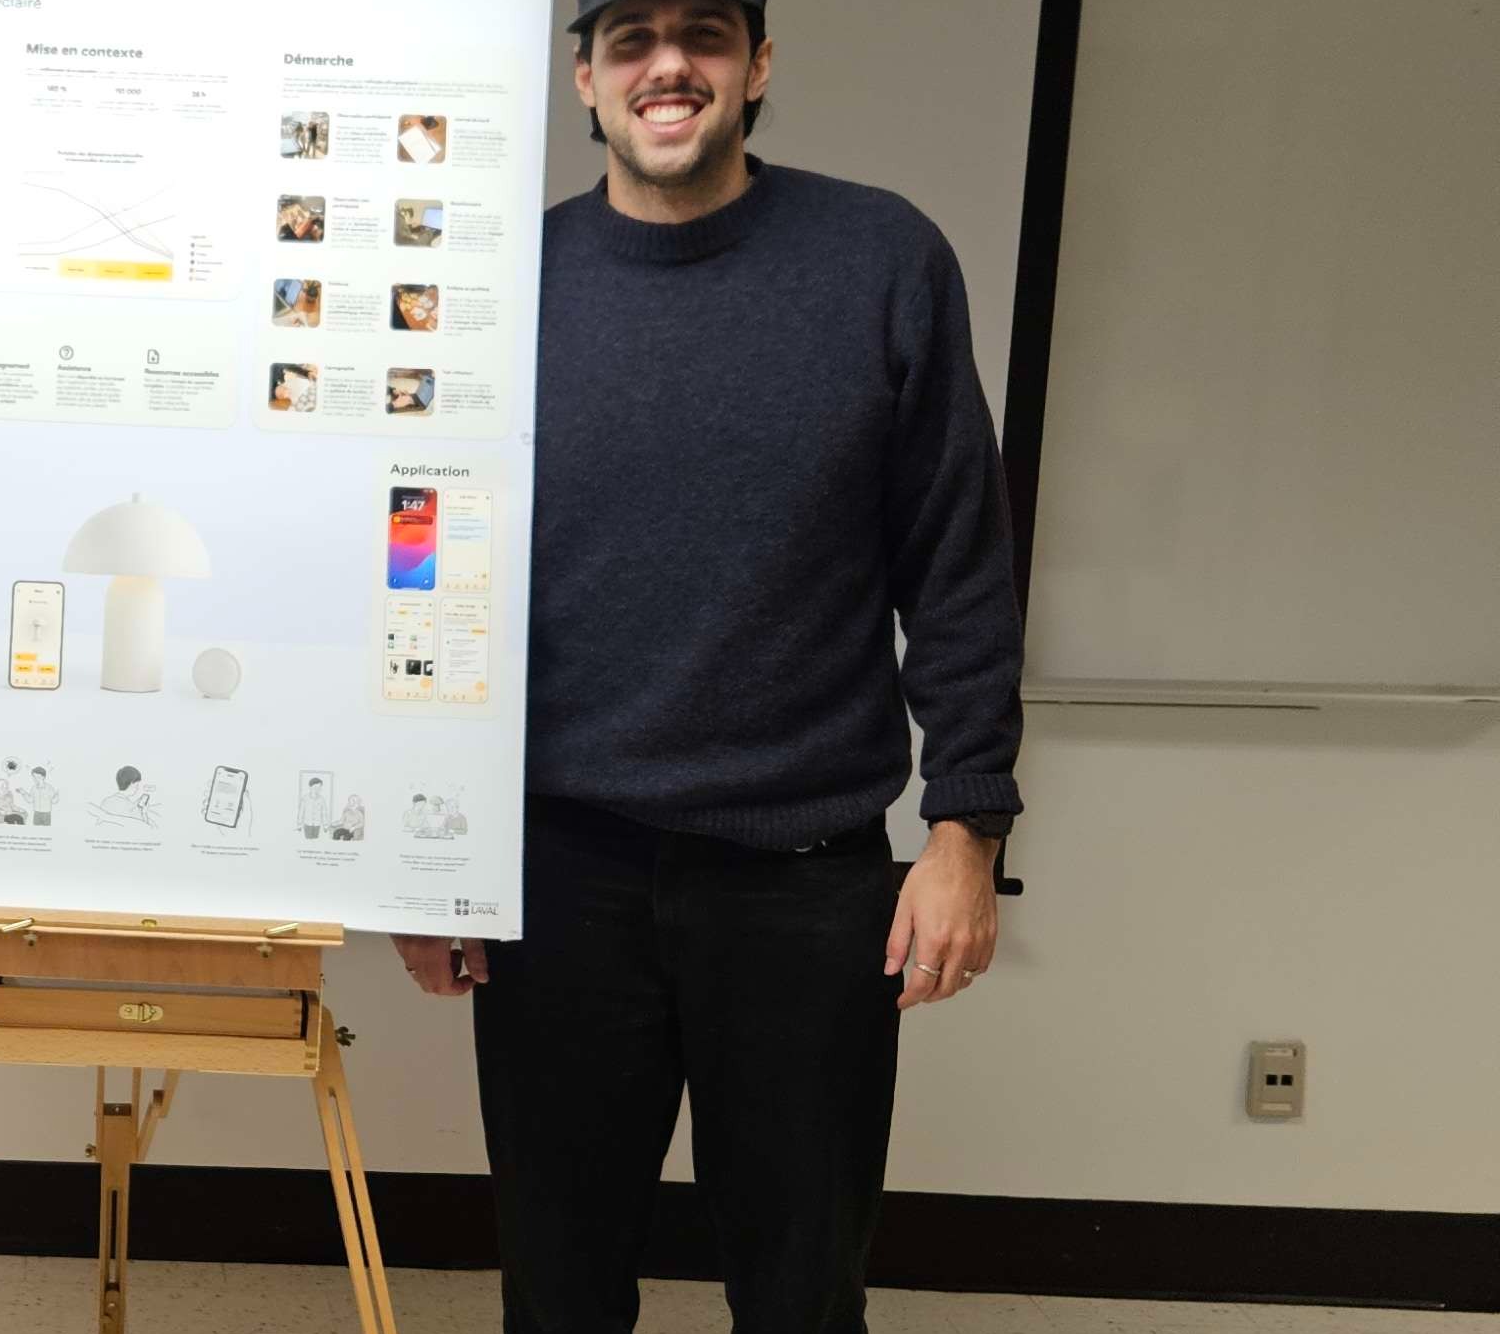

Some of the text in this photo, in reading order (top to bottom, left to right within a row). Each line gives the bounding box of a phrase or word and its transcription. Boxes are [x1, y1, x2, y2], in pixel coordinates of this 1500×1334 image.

[26, 43, 144, 59] Mise en contexte
[283, 53, 354, 67] Démarche
[389, 463, 470, 478] Application
